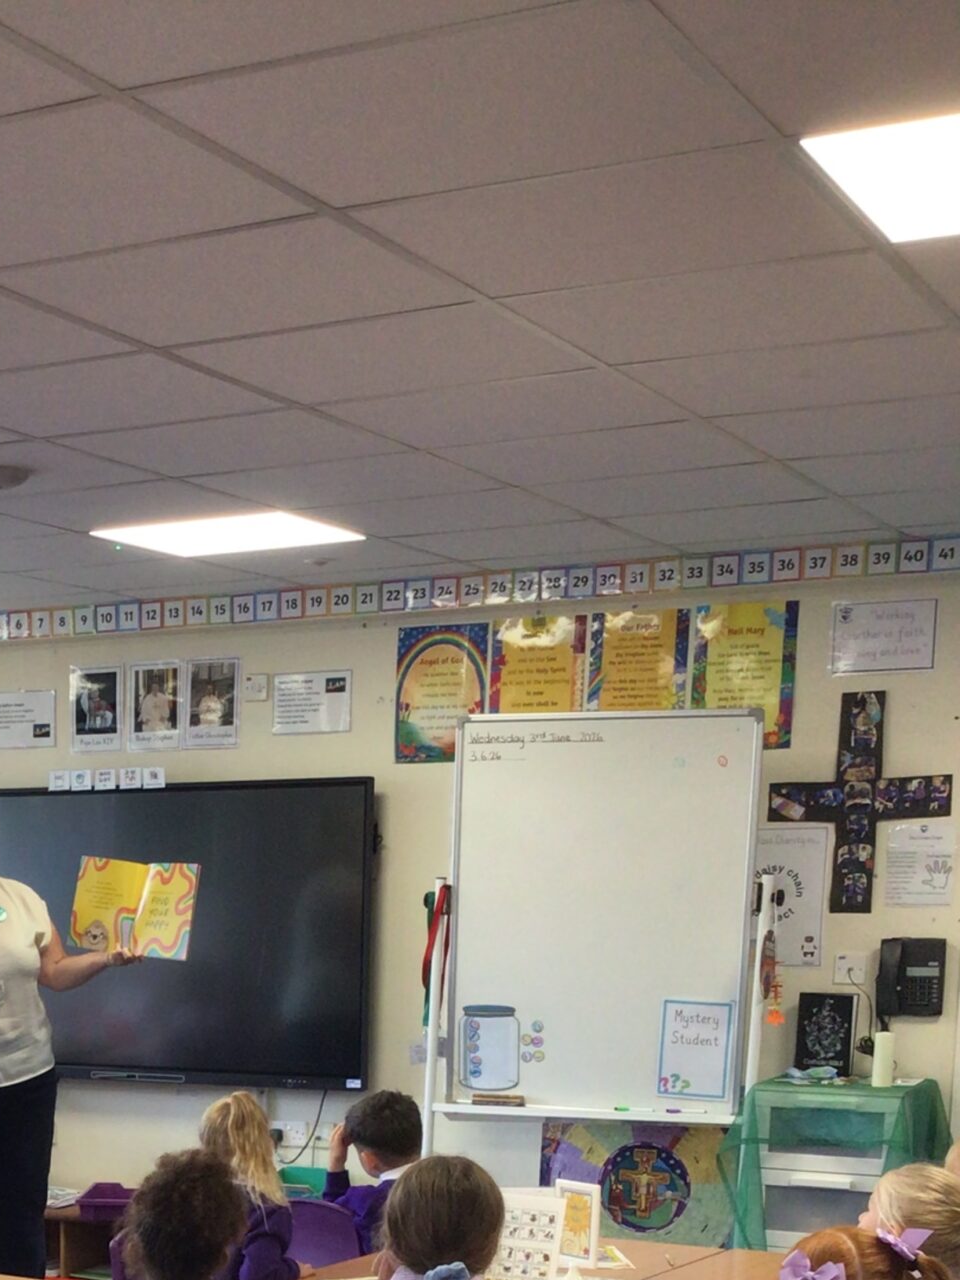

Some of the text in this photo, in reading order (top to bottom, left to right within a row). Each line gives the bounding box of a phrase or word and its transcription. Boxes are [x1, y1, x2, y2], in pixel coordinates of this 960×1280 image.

[16, 620, 22, 630] 6
[38, 618, 44, 628] 7
[59, 617, 66, 627] 8
[81, 615, 87, 625] 9
[100, 613, 112, 623] 10
[124, 611, 134, 621] 11
[146, 610, 157, 620] 12
[169, 608, 180, 618] 13
[191, 606, 203, 616] 14
[214, 604, 226, 615] 15
[237, 603, 249, 614] 16
[261, 601, 273, 612] 17
[285, 599, 297, 609] 18
[310, 597, 322, 607] 19
[334, 595, 349, 606] 20
[361, 593, 373, 604] 21
[386, 590, 400, 601] 22
[412, 588, 426, 599] 23
[438, 586, 452, 596] 24
[464, 585, 479, 596] 25
[492, 581, 506, 592] 26
[518, 580, 533, 591] 27
[546, 577, 561, 589] 28
[572, 576, 588, 588] 29
[600, 574, 616, 586] 30
[630, 572, 644, 584] 31
[659, 569, 674, 580] 32
[687, 567, 703, 579] 33
[716, 564, 733, 576] 34
[748, 562, 764, 573] 35
[778, 559, 794, 571] 36
[809, 557, 826, 569] 37
[840, 554, 858, 566] 38
[873, 552, 890, 564] 39
[904, 550, 924, 562] 40
[938, 547, 955, 560] 41
[743, 626, 764, 635] Mary
[470, 732, 525, 749] Wednesday
[530, 732, 546, 743] 3rd
[550, 732, 571, 742] June
[755, 865, 805, 898] daisy chain
[674, 1009, 720, 1030] Mystery
[671, 1030, 720, 1047] Student
